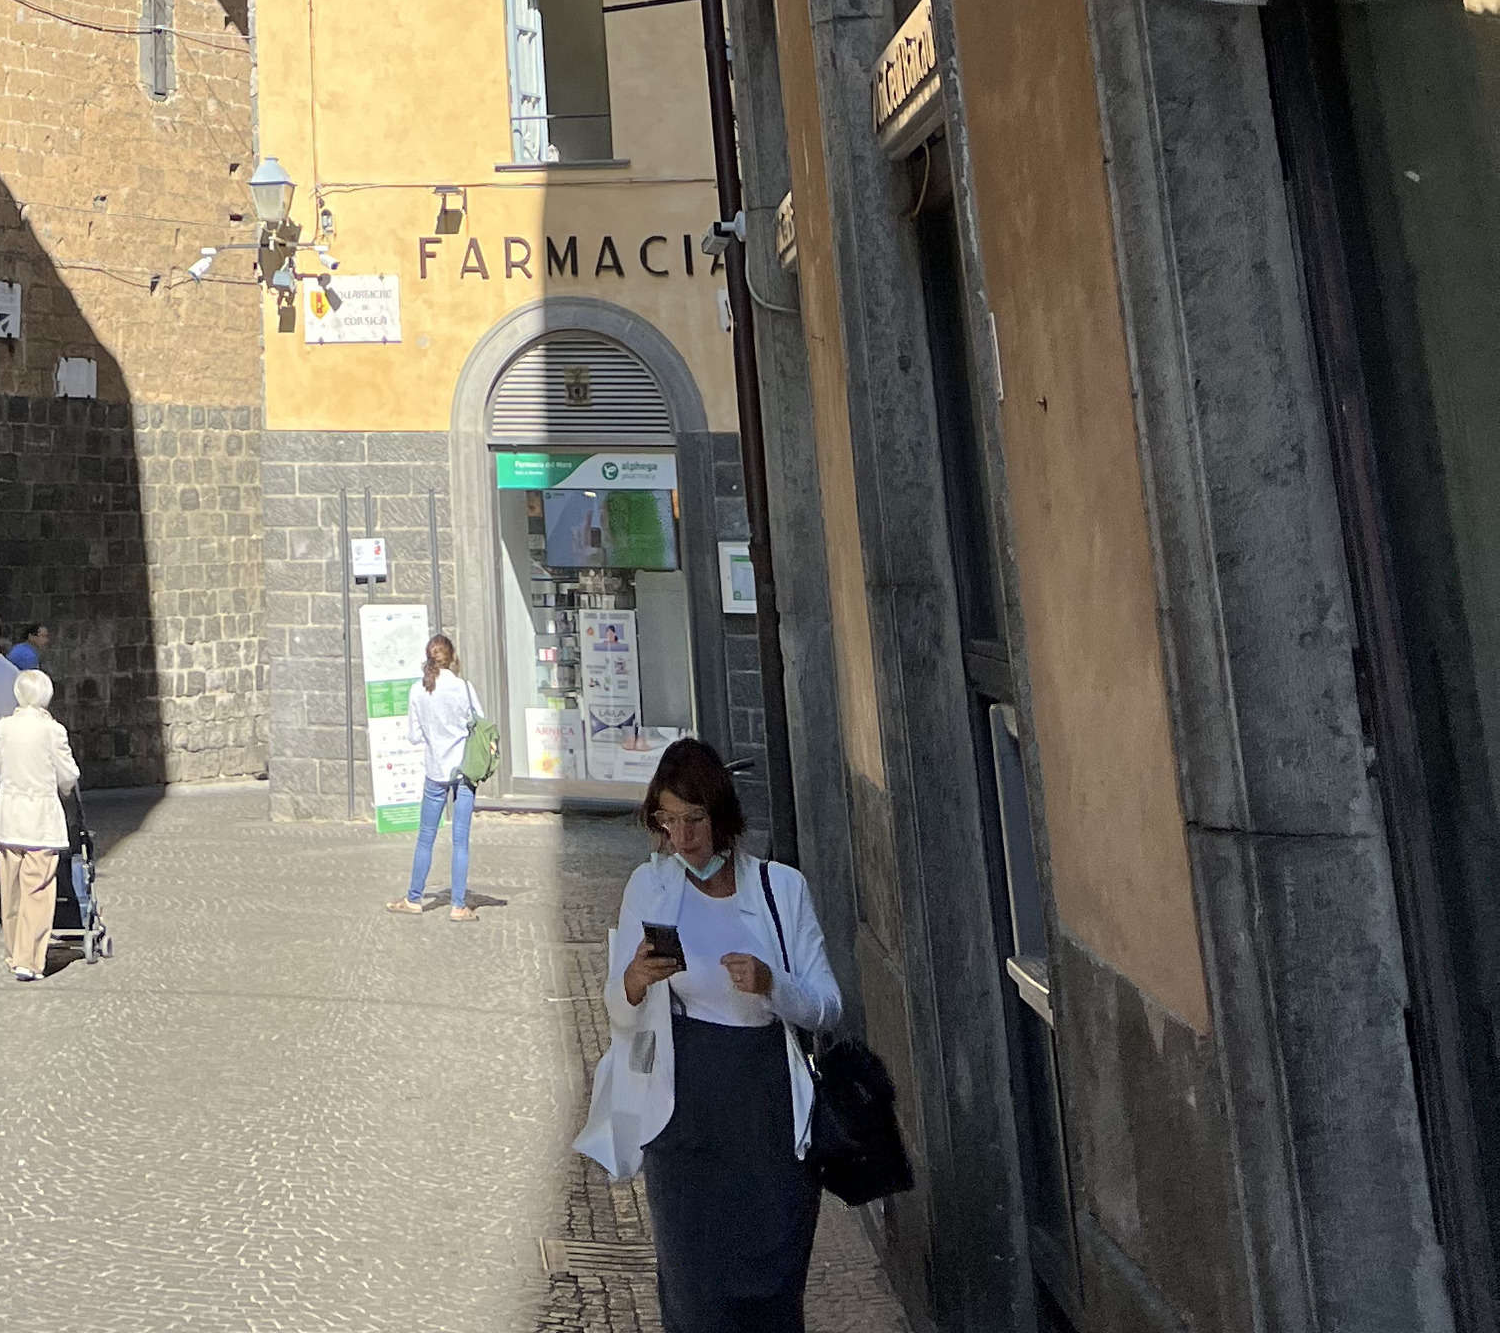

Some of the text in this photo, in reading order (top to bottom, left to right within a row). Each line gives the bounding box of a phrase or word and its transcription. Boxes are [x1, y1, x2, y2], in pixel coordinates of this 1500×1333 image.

[343, 316, 388, 326] CORSICA
[514, 460, 545, 469] Farmacia
[621, 462, 658, 472] alphega
[535, 726, 575, 736] ARNICA
